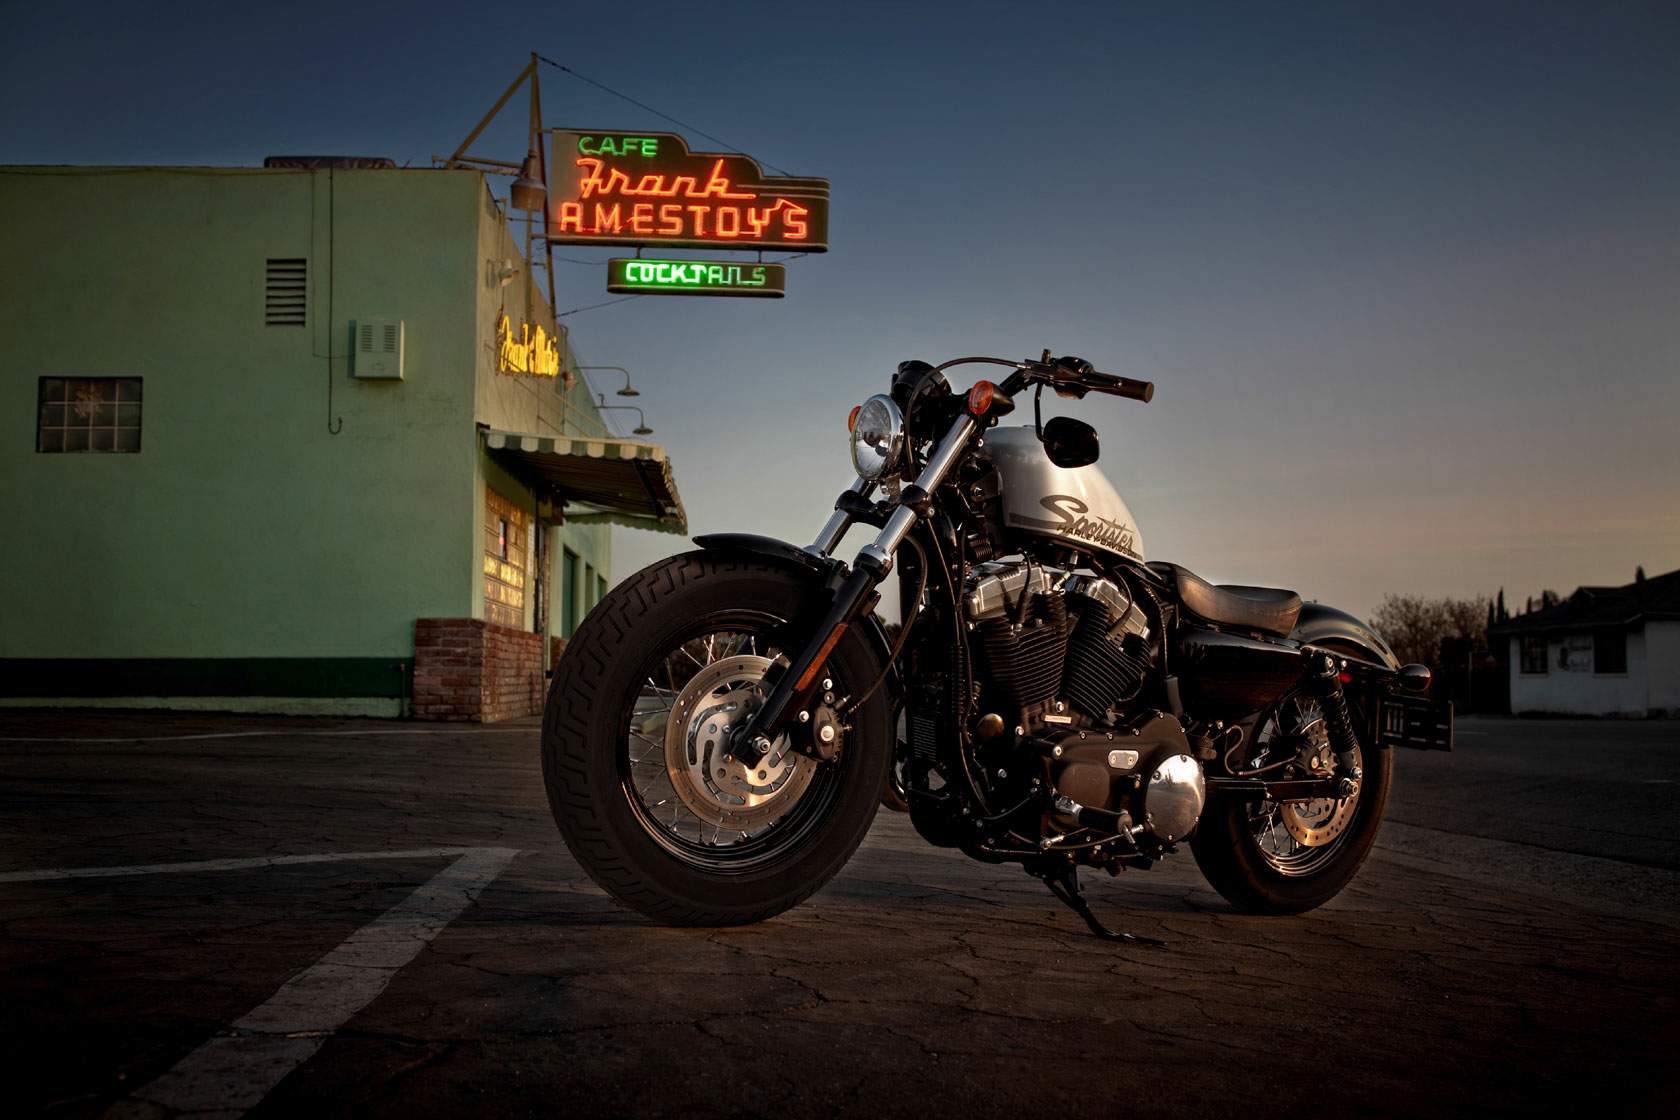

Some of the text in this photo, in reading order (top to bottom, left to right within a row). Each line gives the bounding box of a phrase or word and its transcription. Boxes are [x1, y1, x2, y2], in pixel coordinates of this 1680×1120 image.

[578, 136, 658, 156] CAFE
[576, 158, 757, 198] Frank
[559, 199, 808, 239] AMESTOY'S
[625, 262, 767, 286] COCKTAILS
